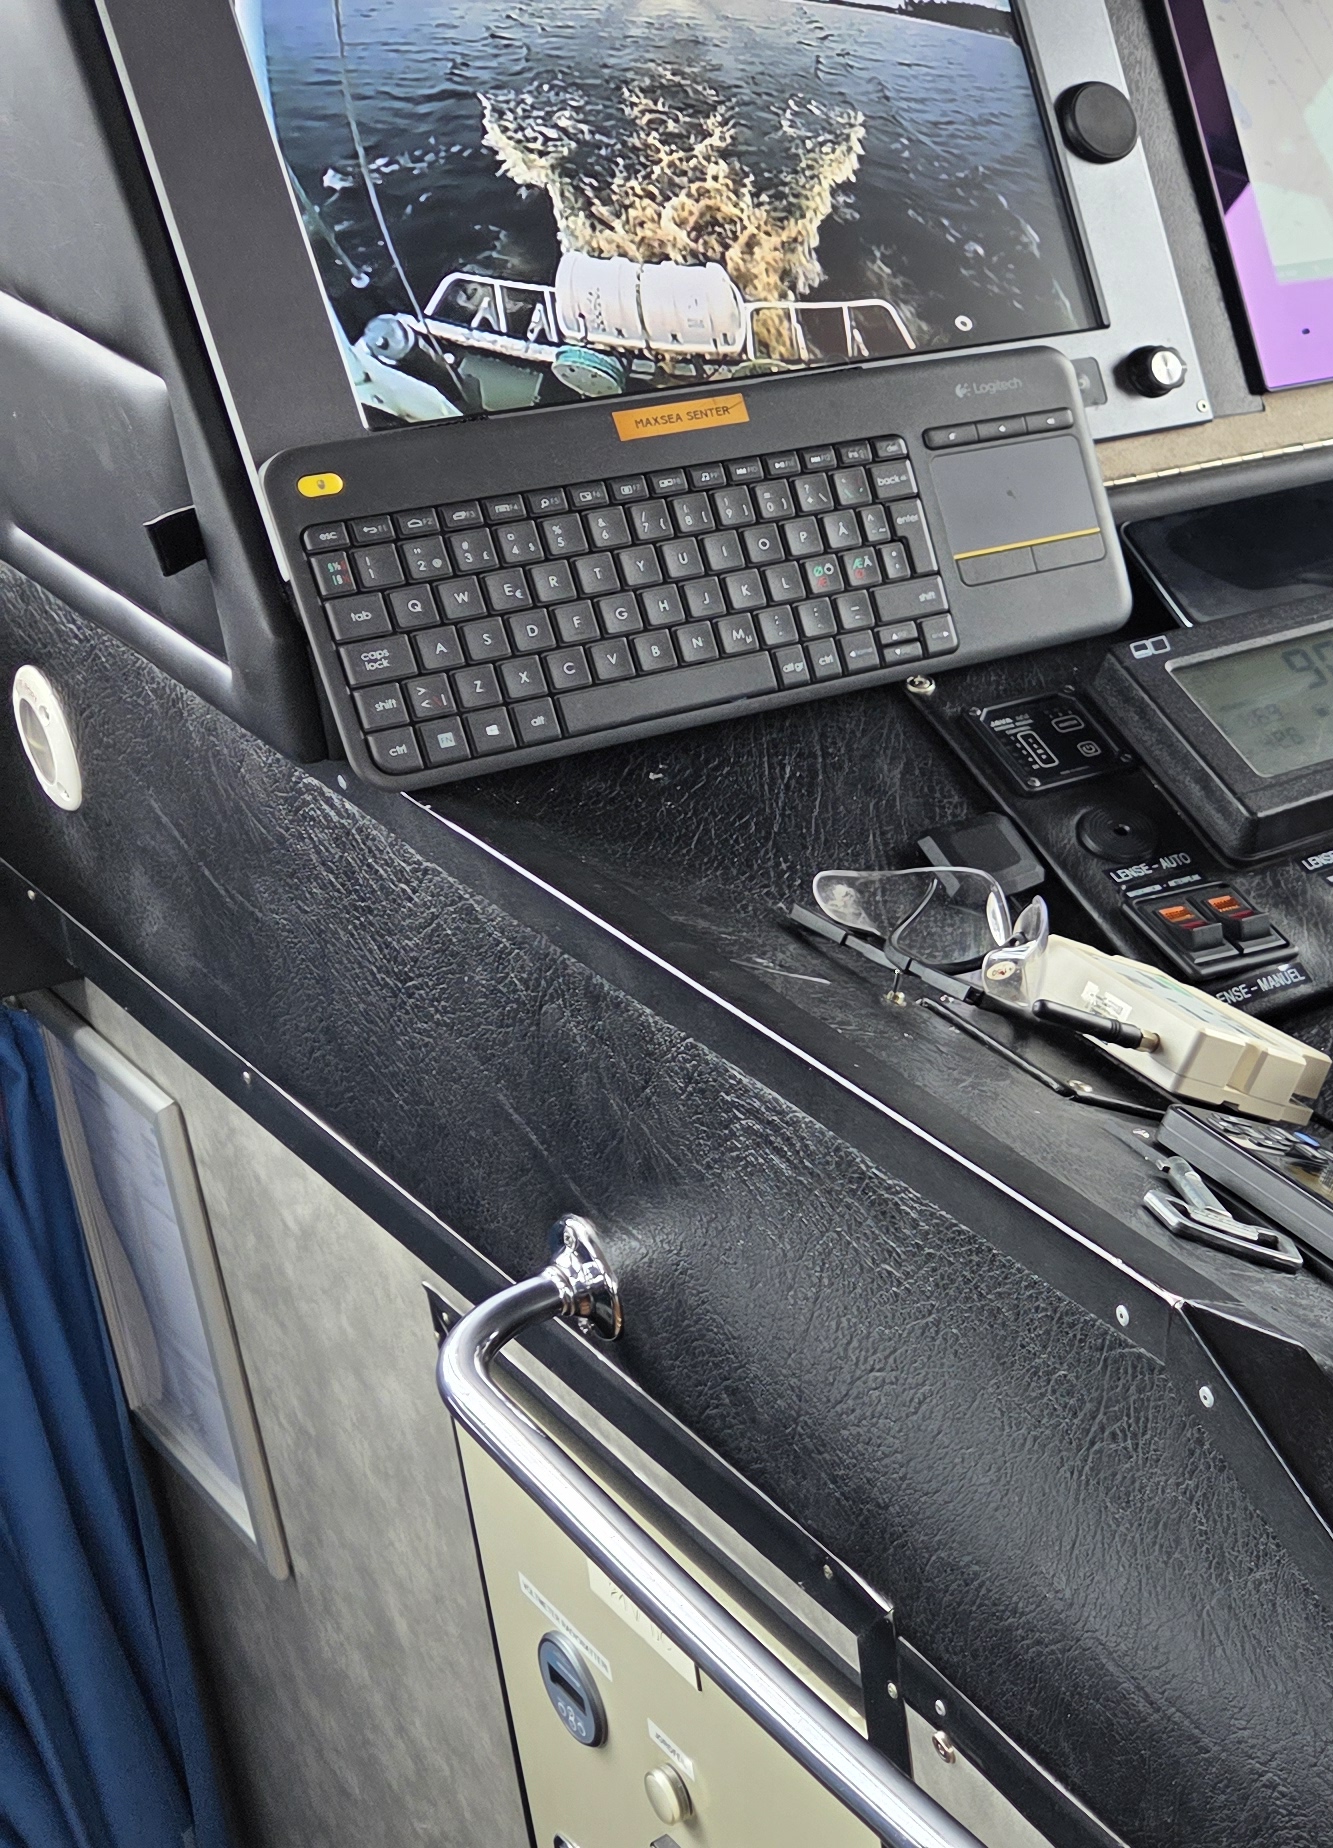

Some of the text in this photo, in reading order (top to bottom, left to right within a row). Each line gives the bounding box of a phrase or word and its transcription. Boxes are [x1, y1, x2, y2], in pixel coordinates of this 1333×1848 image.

[972, 377, 1022, 394] Logitech
[634, 405, 731, 429] MAXSEA SENTER
[877, 475, 901, 486] back
[896, 513, 918, 524] enter
[838, 522, 848, 536] Å
[319, 531, 337, 541] esc
[800, 531, 808, 542] P
[758, 538, 770, 550] O
[679, 552, 688, 564] U
[636, 560, 644, 571] Y
[594, 568, 602, 579] T
[549, 575, 559, 587] R
[782, 578, 790, 589] L
[741, 585, 750, 596] K
[454, 592, 469, 604] W
[407, 600, 422, 613] Q
[659, 600, 669, 612] H
[350, 611, 372, 622] tab
[615, 607, 628, 620] G
[573, 616, 581, 628] F
[527, 625, 538, 637] D
[732, 628, 745, 641] M
[482, 633, 492, 645] S
[692, 636, 703, 649] N
[435, 643, 447, 654] A
[651, 645, 660, 657] B
[361, 649, 389, 664] caps
[606, 653, 617, 665] V
[819, 654, 834, 666] ctrl
[365, 658, 390, 671] lock
[563, 662, 576, 674] C
[518, 671, 530, 684] X
[474, 680, 484, 693] Z
[374, 699, 397, 712] shift
[531, 715, 545, 726] alt
[389, 744, 407, 756] ctrl
[1109, 862, 1153, 883] LENSE
[1159, 852, 1191, 870] AUTO
[1215, 983, 1252, 1005] ENSE
[1256, 968, 1306, 992] MANUEL
